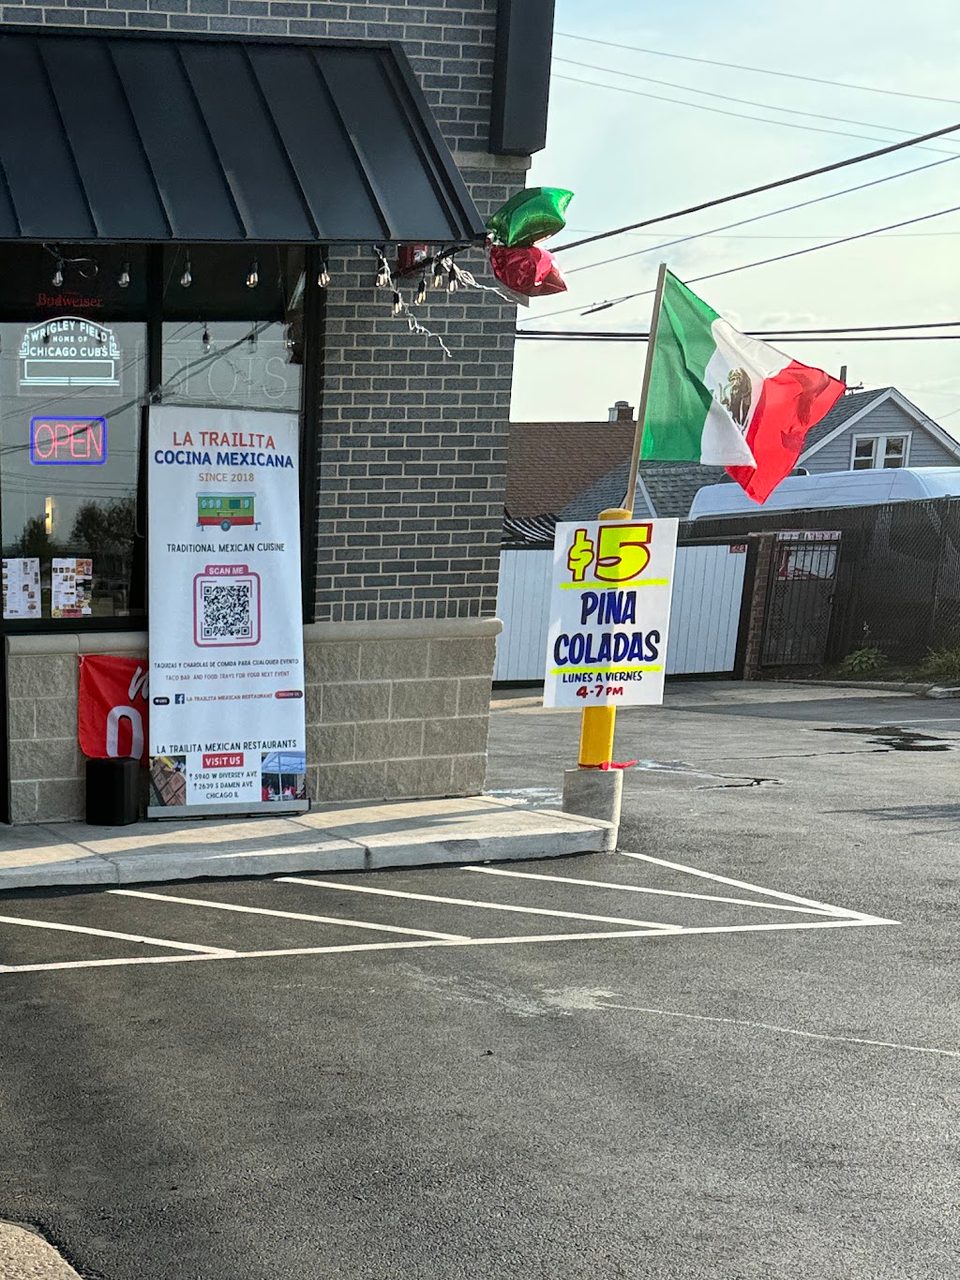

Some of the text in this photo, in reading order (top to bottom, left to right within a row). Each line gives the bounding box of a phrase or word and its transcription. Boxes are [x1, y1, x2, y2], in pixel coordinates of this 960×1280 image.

[36, 292, 103, 307] Budweiser
[31, 320, 107, 342] WRIGLEY FIELD
[30, 347, 108, 357] CHICAGO CUBS
[35, 424, 102, 458] OPEN
[173, 431, 276, 449] LA TRAILITA
[154, 450, 294, 468] COCINA MEXICANA
[198, 472, 255, 482] SINCE 2018
[167, 542, 285, 552] TRADITIONAL MEXICAN CUISINE
[567, 523, 653, 582] $5
[209, 566, 230, 574] SCAN
[554, 630, 661, 666] COLADAS
[562, 670, 642, 683] LUNES A VIERNES
[156, 740, 297, 754] LA TRAILITA MEXICAN RESTAURANTS
[229, 756, 240, 765] US
